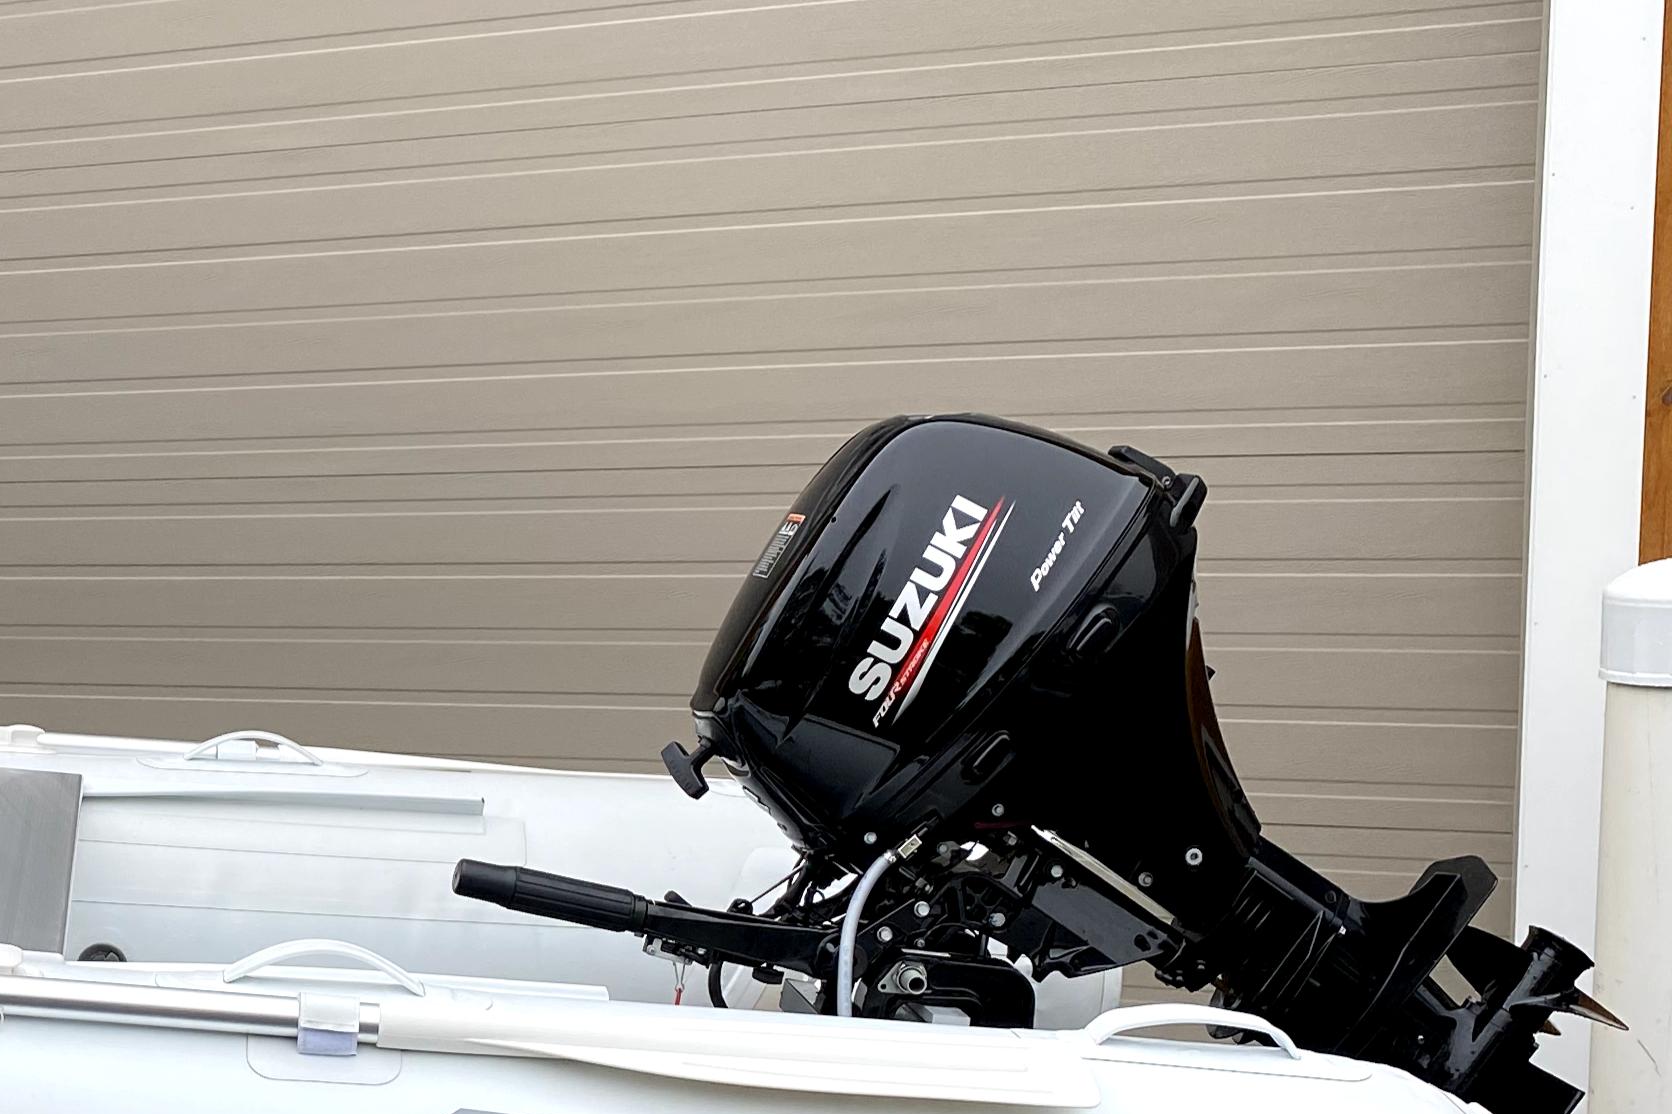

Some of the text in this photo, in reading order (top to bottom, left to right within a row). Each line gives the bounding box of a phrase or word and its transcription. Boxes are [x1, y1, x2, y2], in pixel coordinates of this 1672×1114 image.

[1030, 500, 1085, 592] Power Tilt
[848, 494, 989, 701] SUZUKI
[872, 681, 901, 729] FOUR
